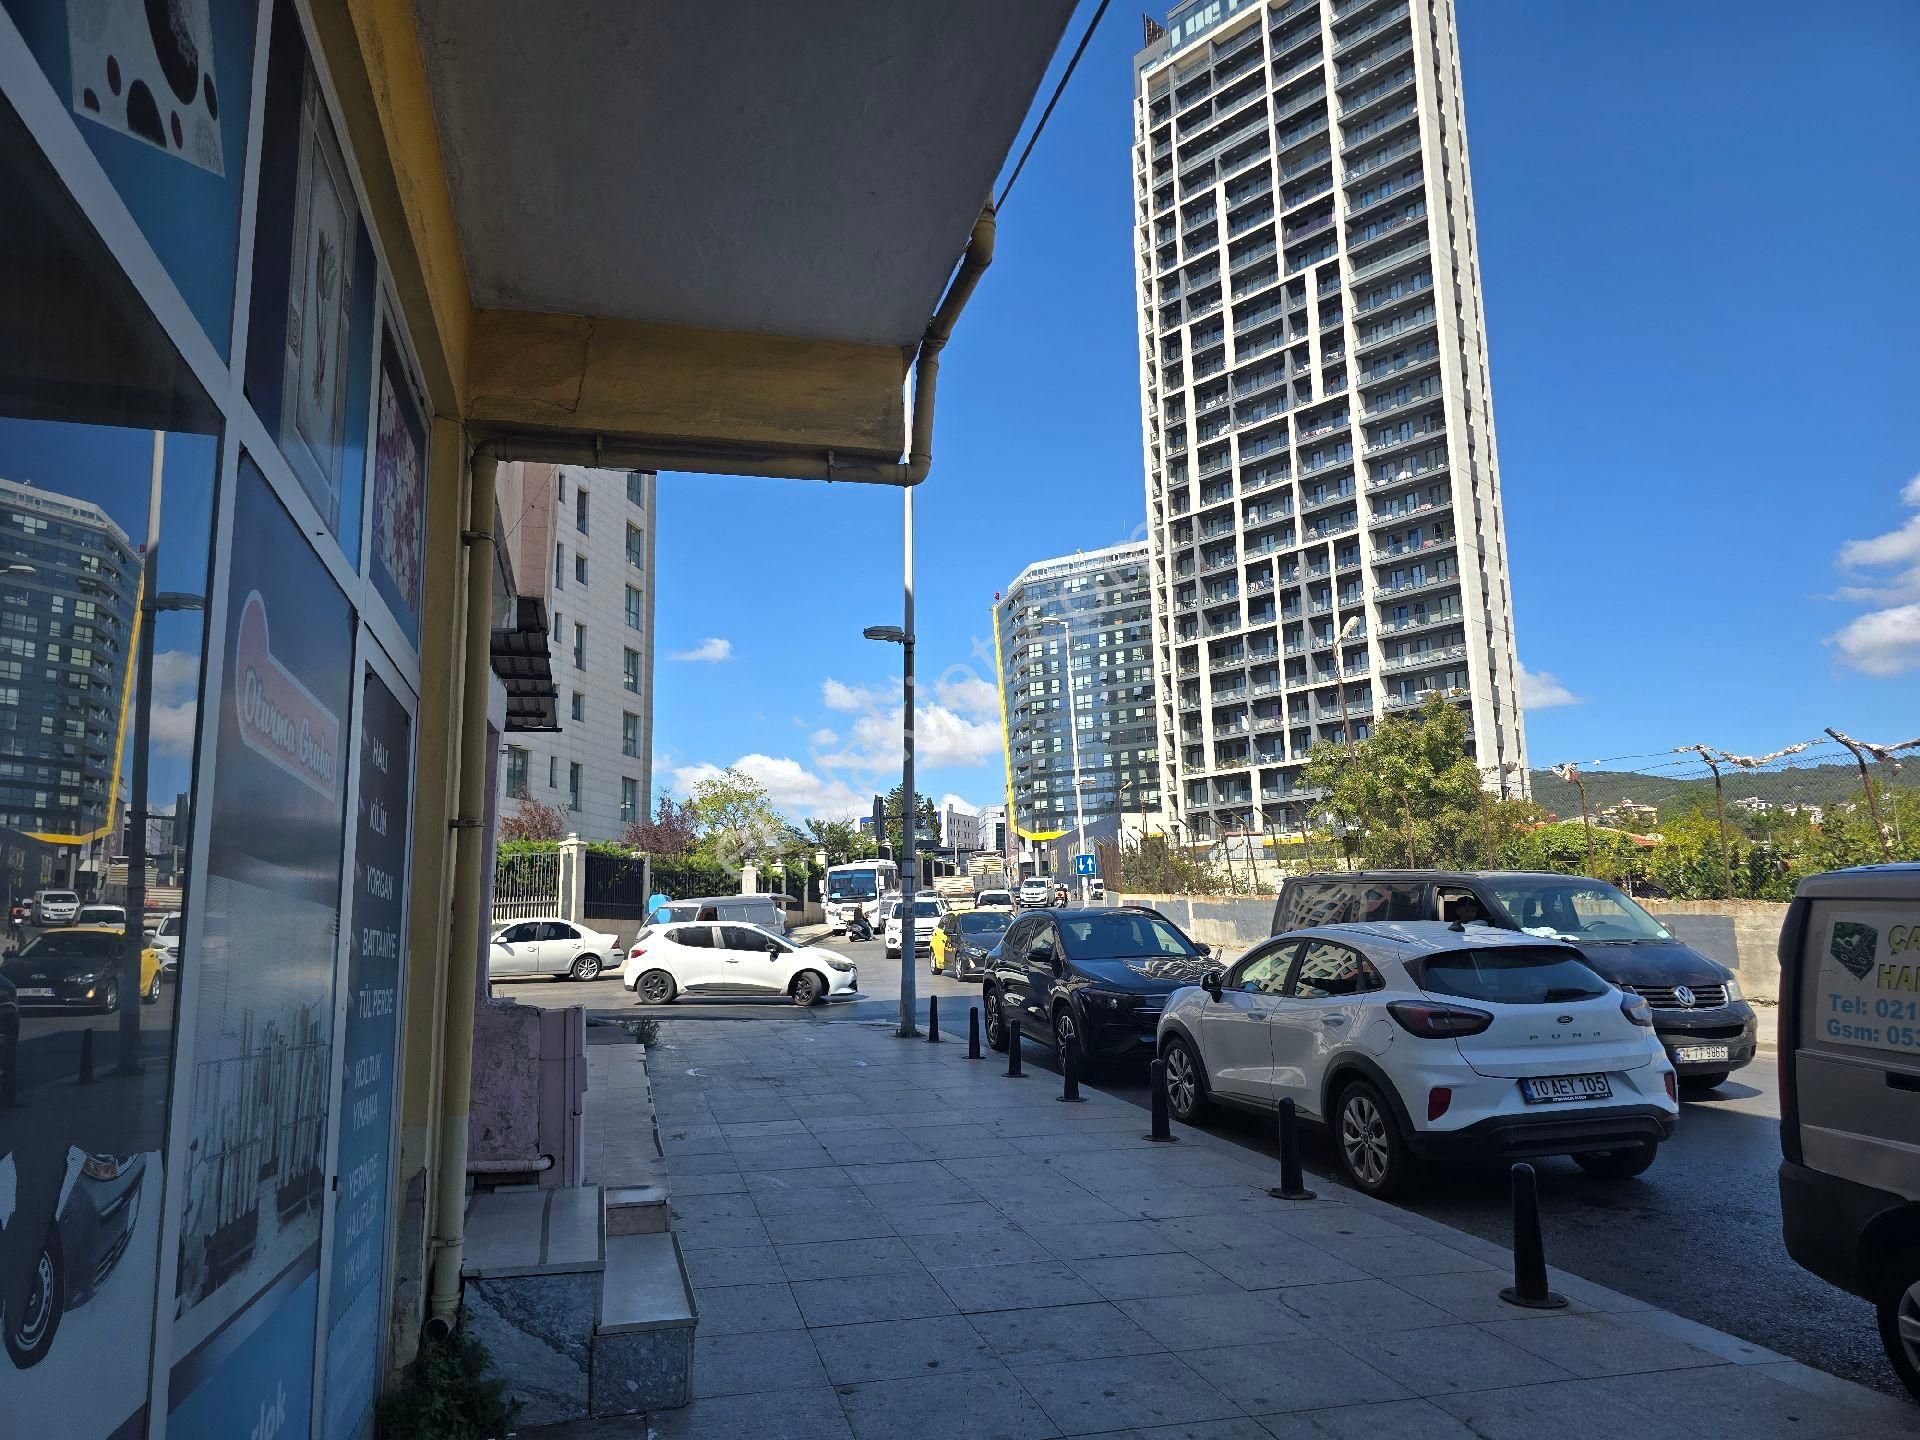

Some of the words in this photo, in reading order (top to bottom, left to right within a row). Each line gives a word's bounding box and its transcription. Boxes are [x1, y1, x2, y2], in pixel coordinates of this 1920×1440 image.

[372, 736, 389, 775] HALI
[366, 864, 393, 901] YORGAN
[362, 925, 397, 959] BATTANİYE
[359, 983, 372, 1019] TÜL
[372, 988, 394, 1017] PERDE
[1828, 993, 1868, 1015] Tel:
[1875, 998, 1920, 1021] 021
[1827, 1018, 1880, 1042] Gsm:
[354, 1052, 382, 1089] KOLTUK
[1531, 1080, 1549, 1097] 10
[1551, 1078, 1577, 1095] AEY
[1579, 1076, 1606, 1093] 105
[353, 1092, 378, 1132] YIKAMA
